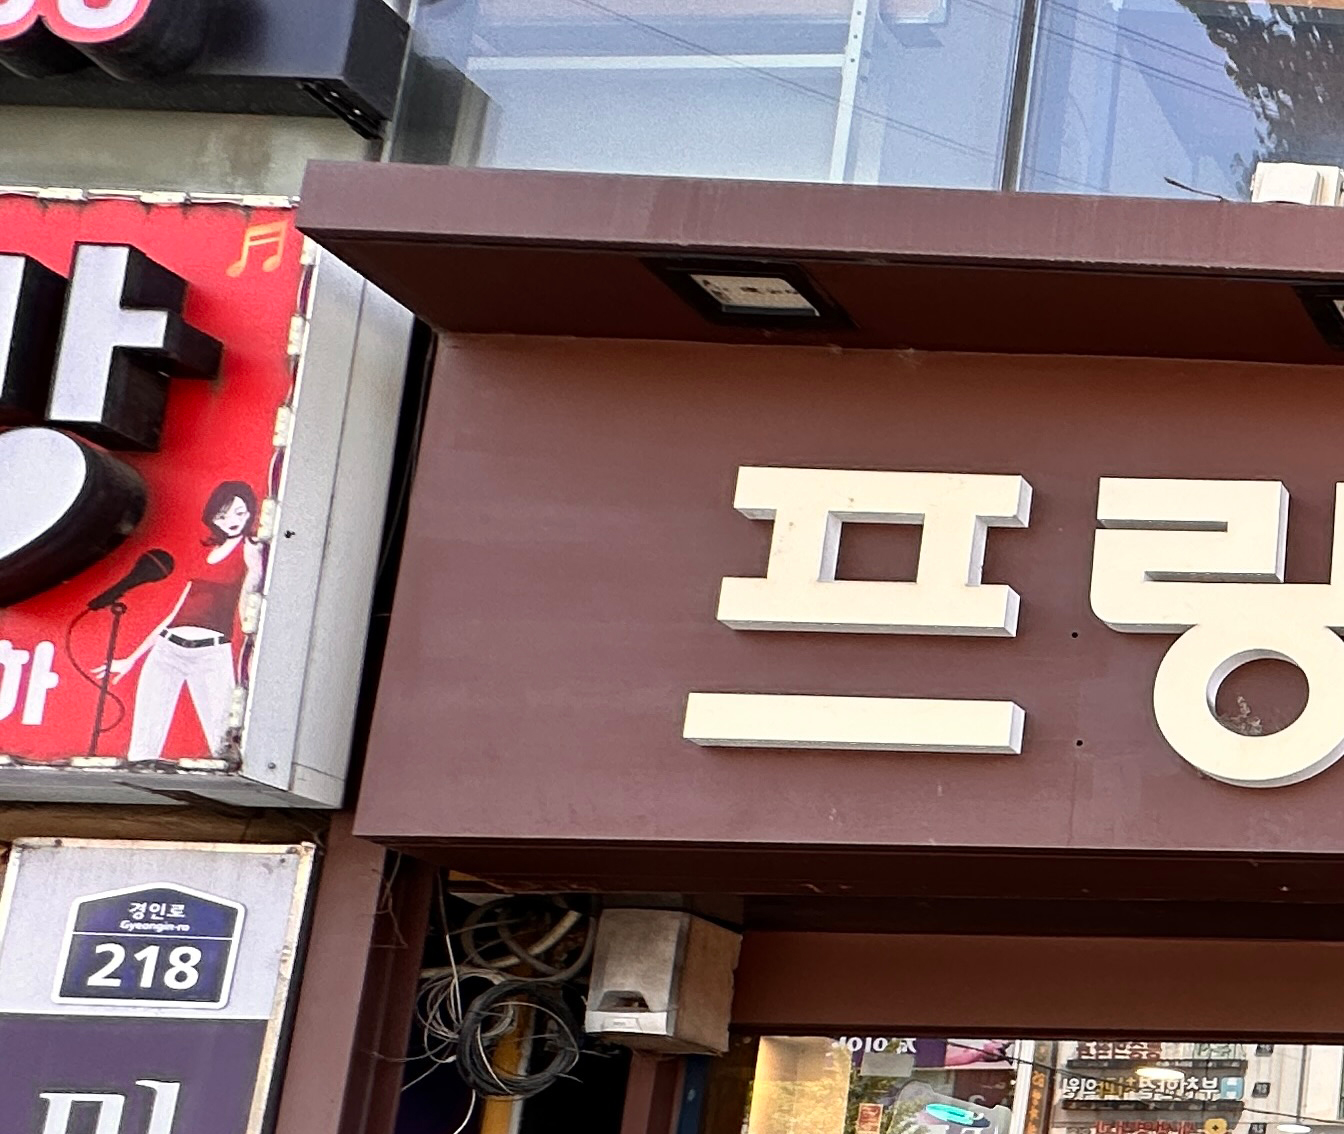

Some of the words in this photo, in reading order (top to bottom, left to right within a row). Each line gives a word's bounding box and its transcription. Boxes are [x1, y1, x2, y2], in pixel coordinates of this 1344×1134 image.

[128, 901, 186, 920] 경인로
[120, 920, 190, 933] Gyeongin-ro
[86, 943, 202, 990] 218
